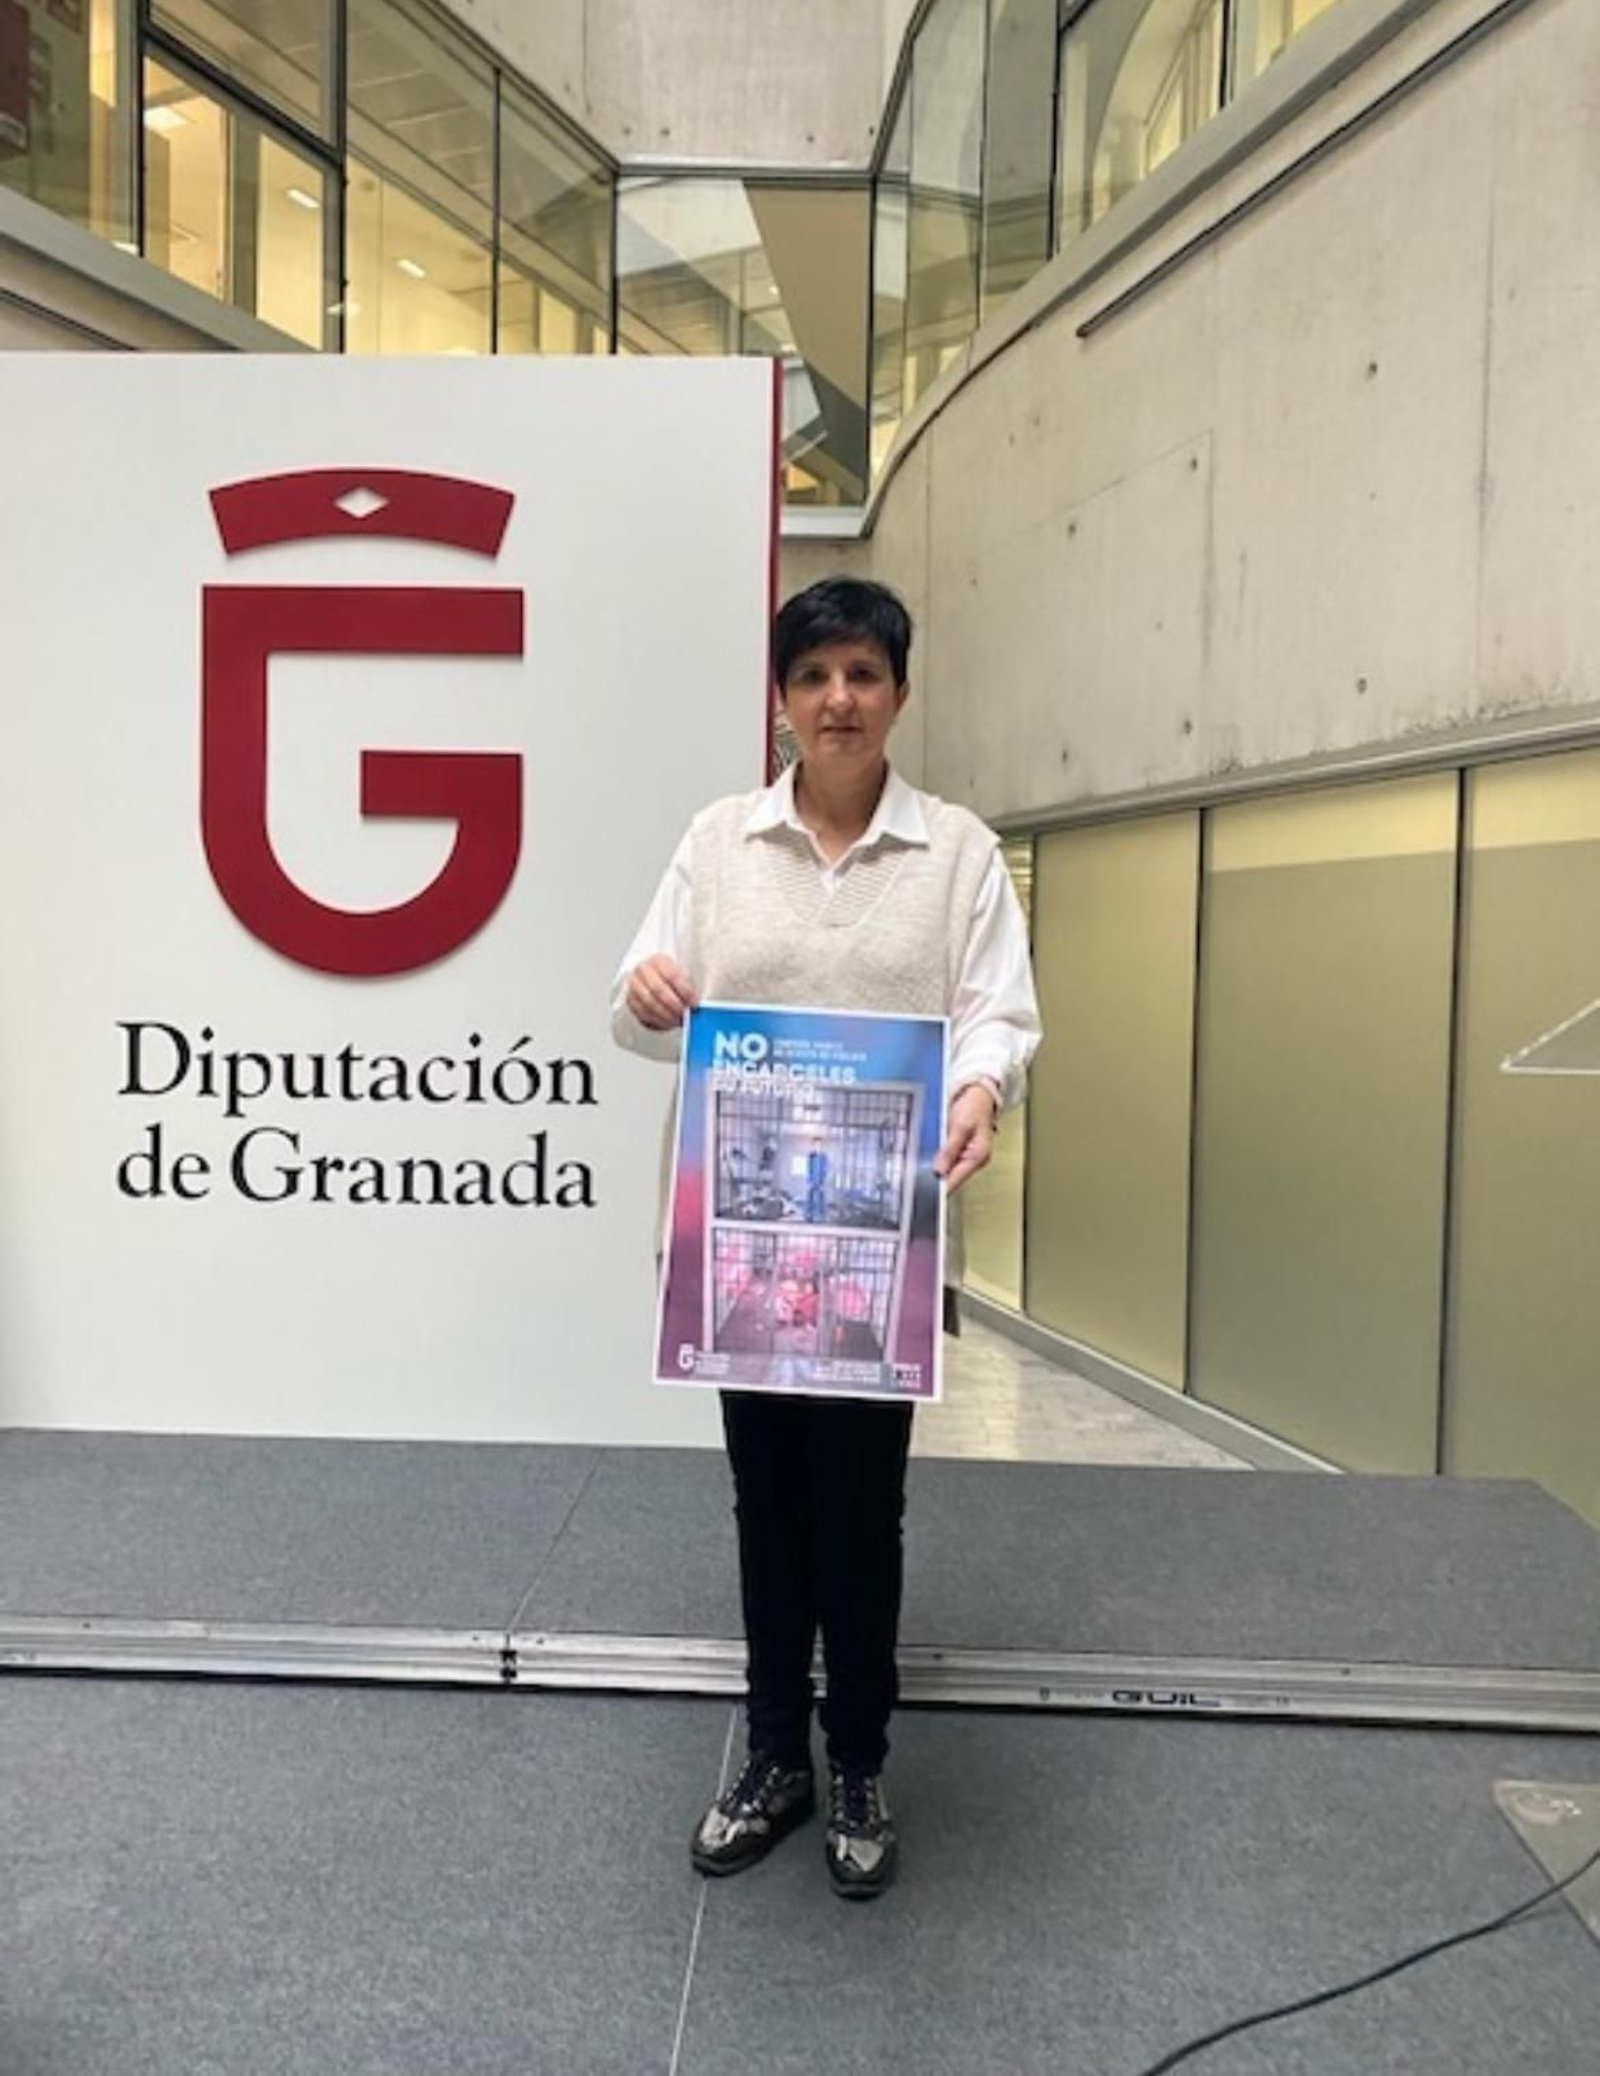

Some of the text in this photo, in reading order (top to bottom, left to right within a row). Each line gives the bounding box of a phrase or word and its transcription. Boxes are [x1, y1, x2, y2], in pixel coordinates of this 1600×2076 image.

[714, 1031, 768, 1061] NO
[116, 1021, 599, 1119] Diputación
[712, 1060, 856, 1084] ENCARCELES
[116, 1122, 598, 1209] de Granada
[1112, 1689, 1221, 1708] GUIL
